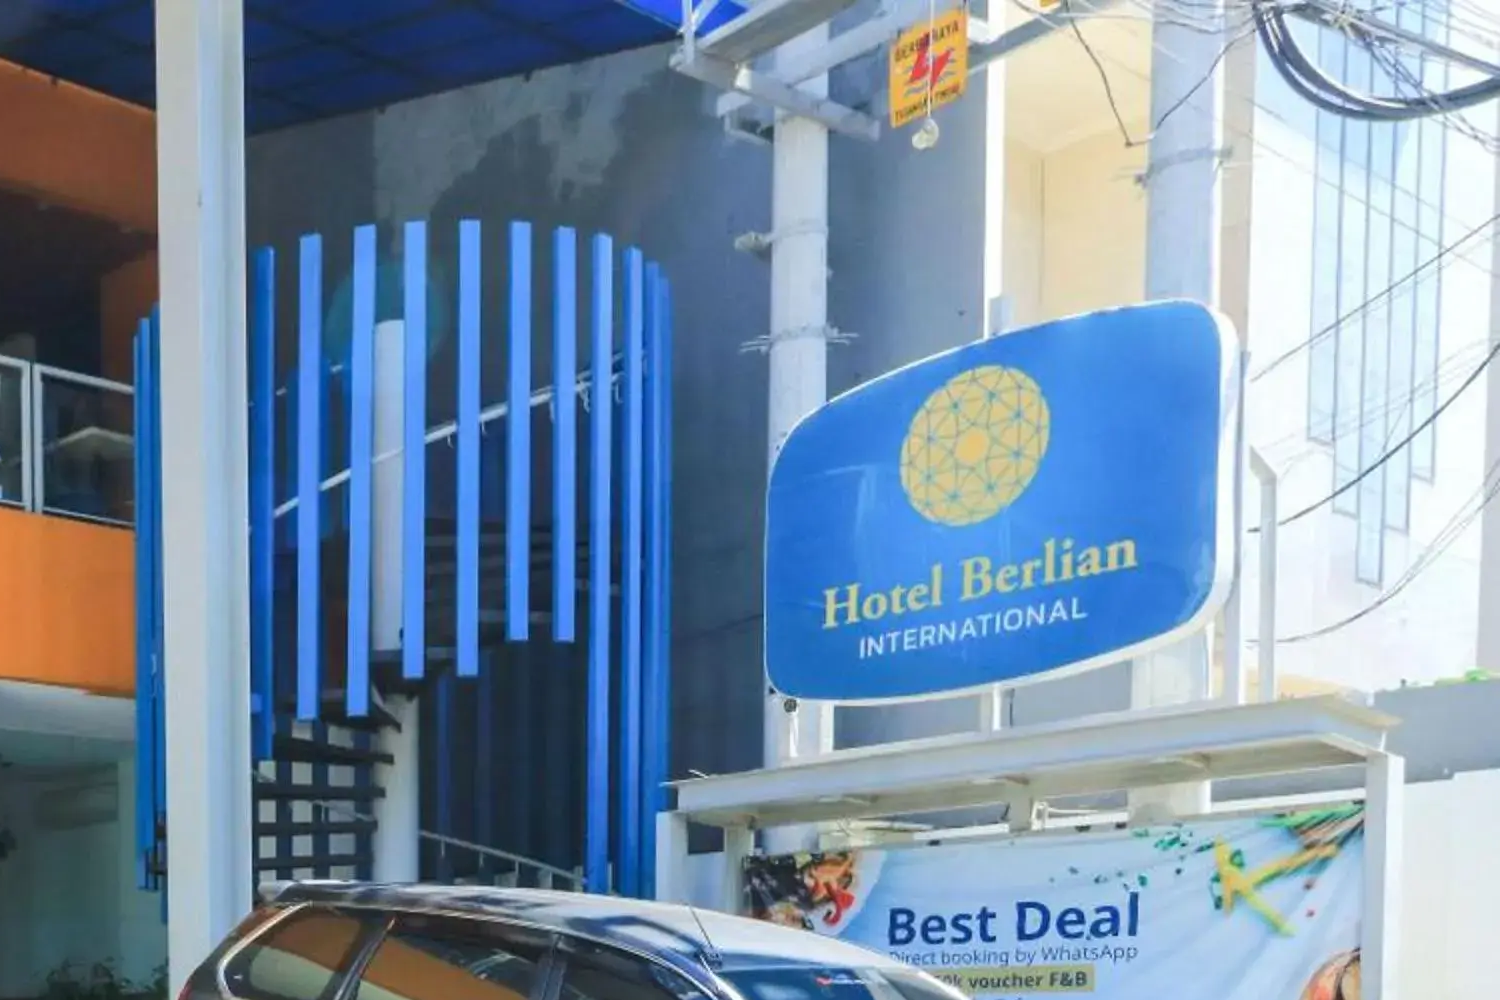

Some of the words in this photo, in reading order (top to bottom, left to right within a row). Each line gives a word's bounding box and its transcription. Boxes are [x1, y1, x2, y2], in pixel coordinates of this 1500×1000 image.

[822, 562, 943, 629] Hotel
[959, 537, 1138, 601] Berlian
[859, 597, 1089, 660] INTERNATIONAL
[888, 906, 997, 946] Best
[1016, 891, 1139, 941] Deal
[941, 950, 1009, 967] booking
[1015, 948, 1037, 964] by
[1041, 945, 1139, 965] WhatsApp
[968, 972, 1043, 988] voucher
[1049, 970, 1088, 988] F&B
